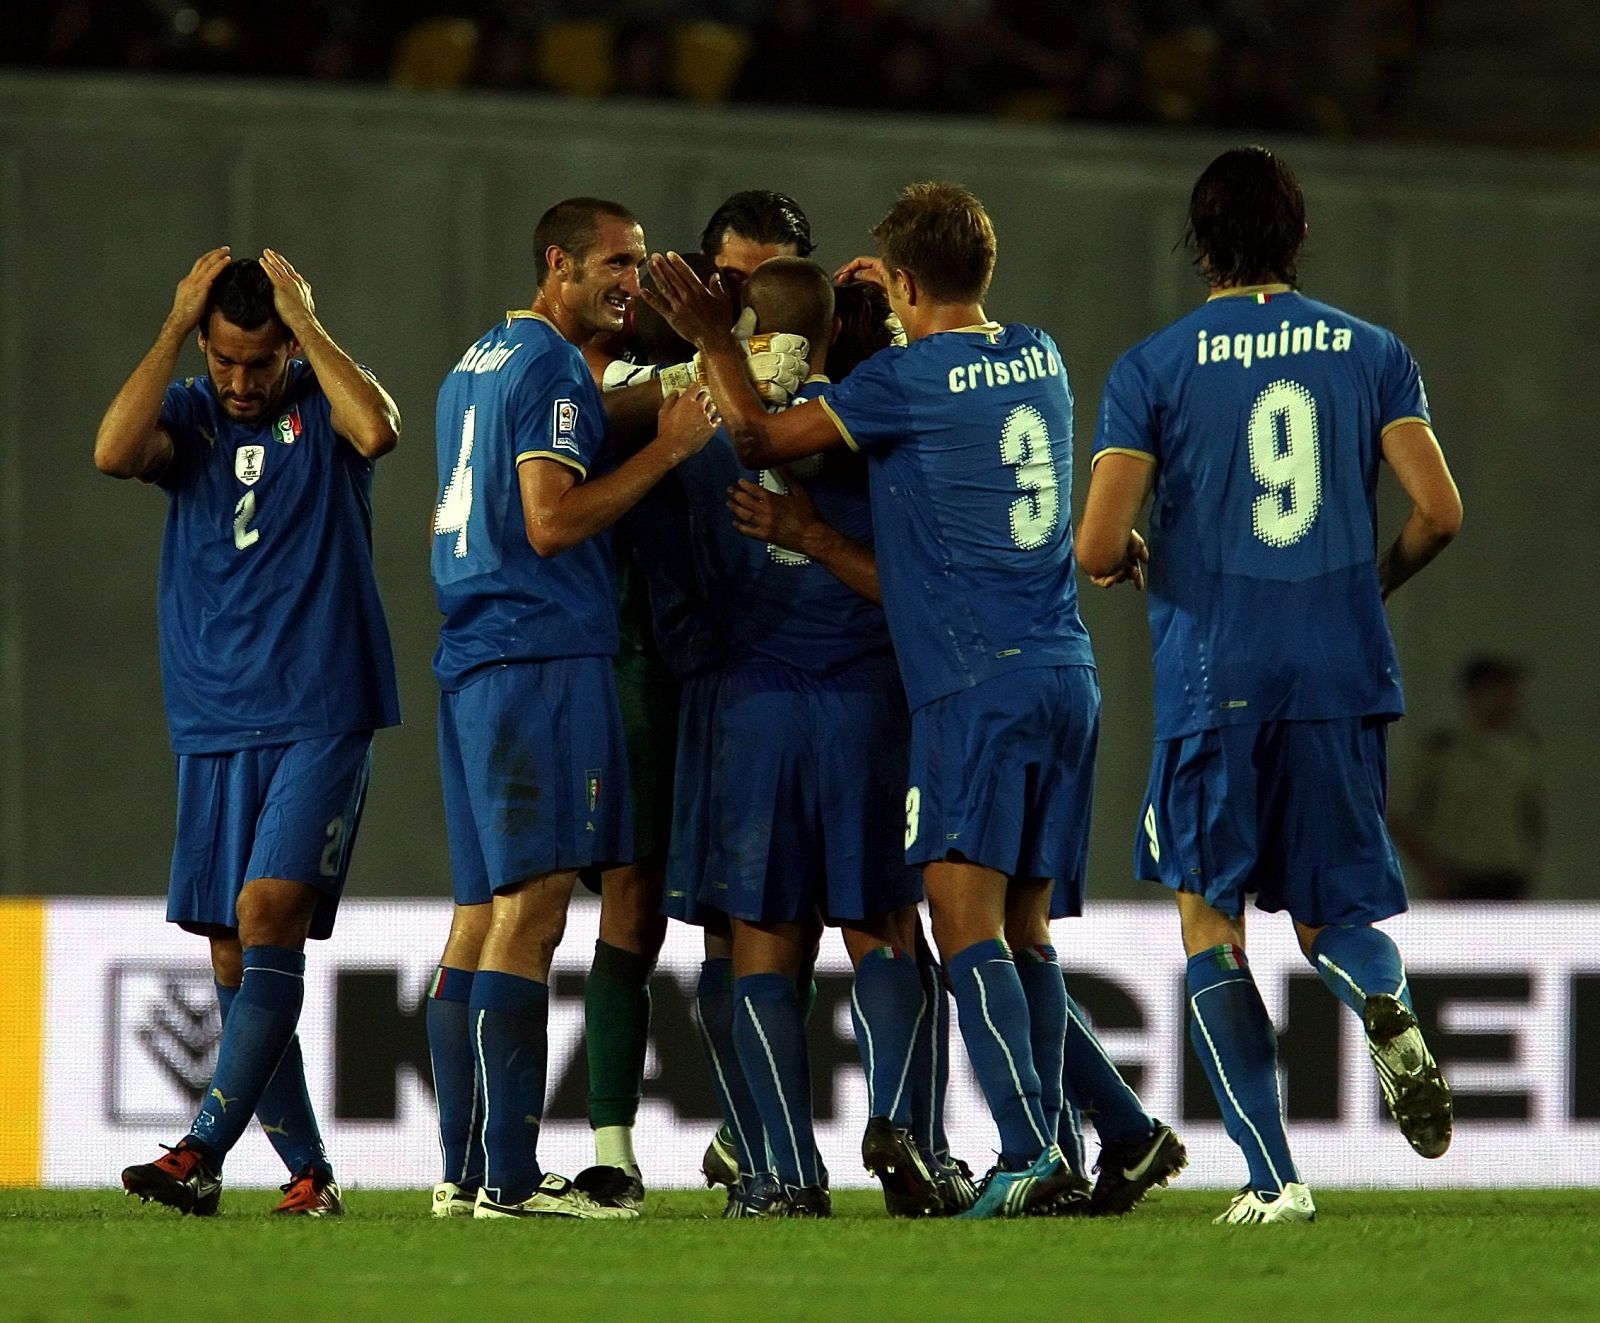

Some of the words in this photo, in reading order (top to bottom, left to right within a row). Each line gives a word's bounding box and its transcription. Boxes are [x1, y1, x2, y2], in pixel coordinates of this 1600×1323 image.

[949, 346, 1060, 393] criscito
[1198, 320, 1352, 369] iaquinta
[434, 404, 477, 559] 4
[999, 404, 1060, 551] 3
[1248, 378, 1323, 549] 9
[233, 489, 260, 550] 2
[320, 815, 345, 877] 2
[904, 786, 921, 851] 3
[1143, 803, 1160, 864] 9
